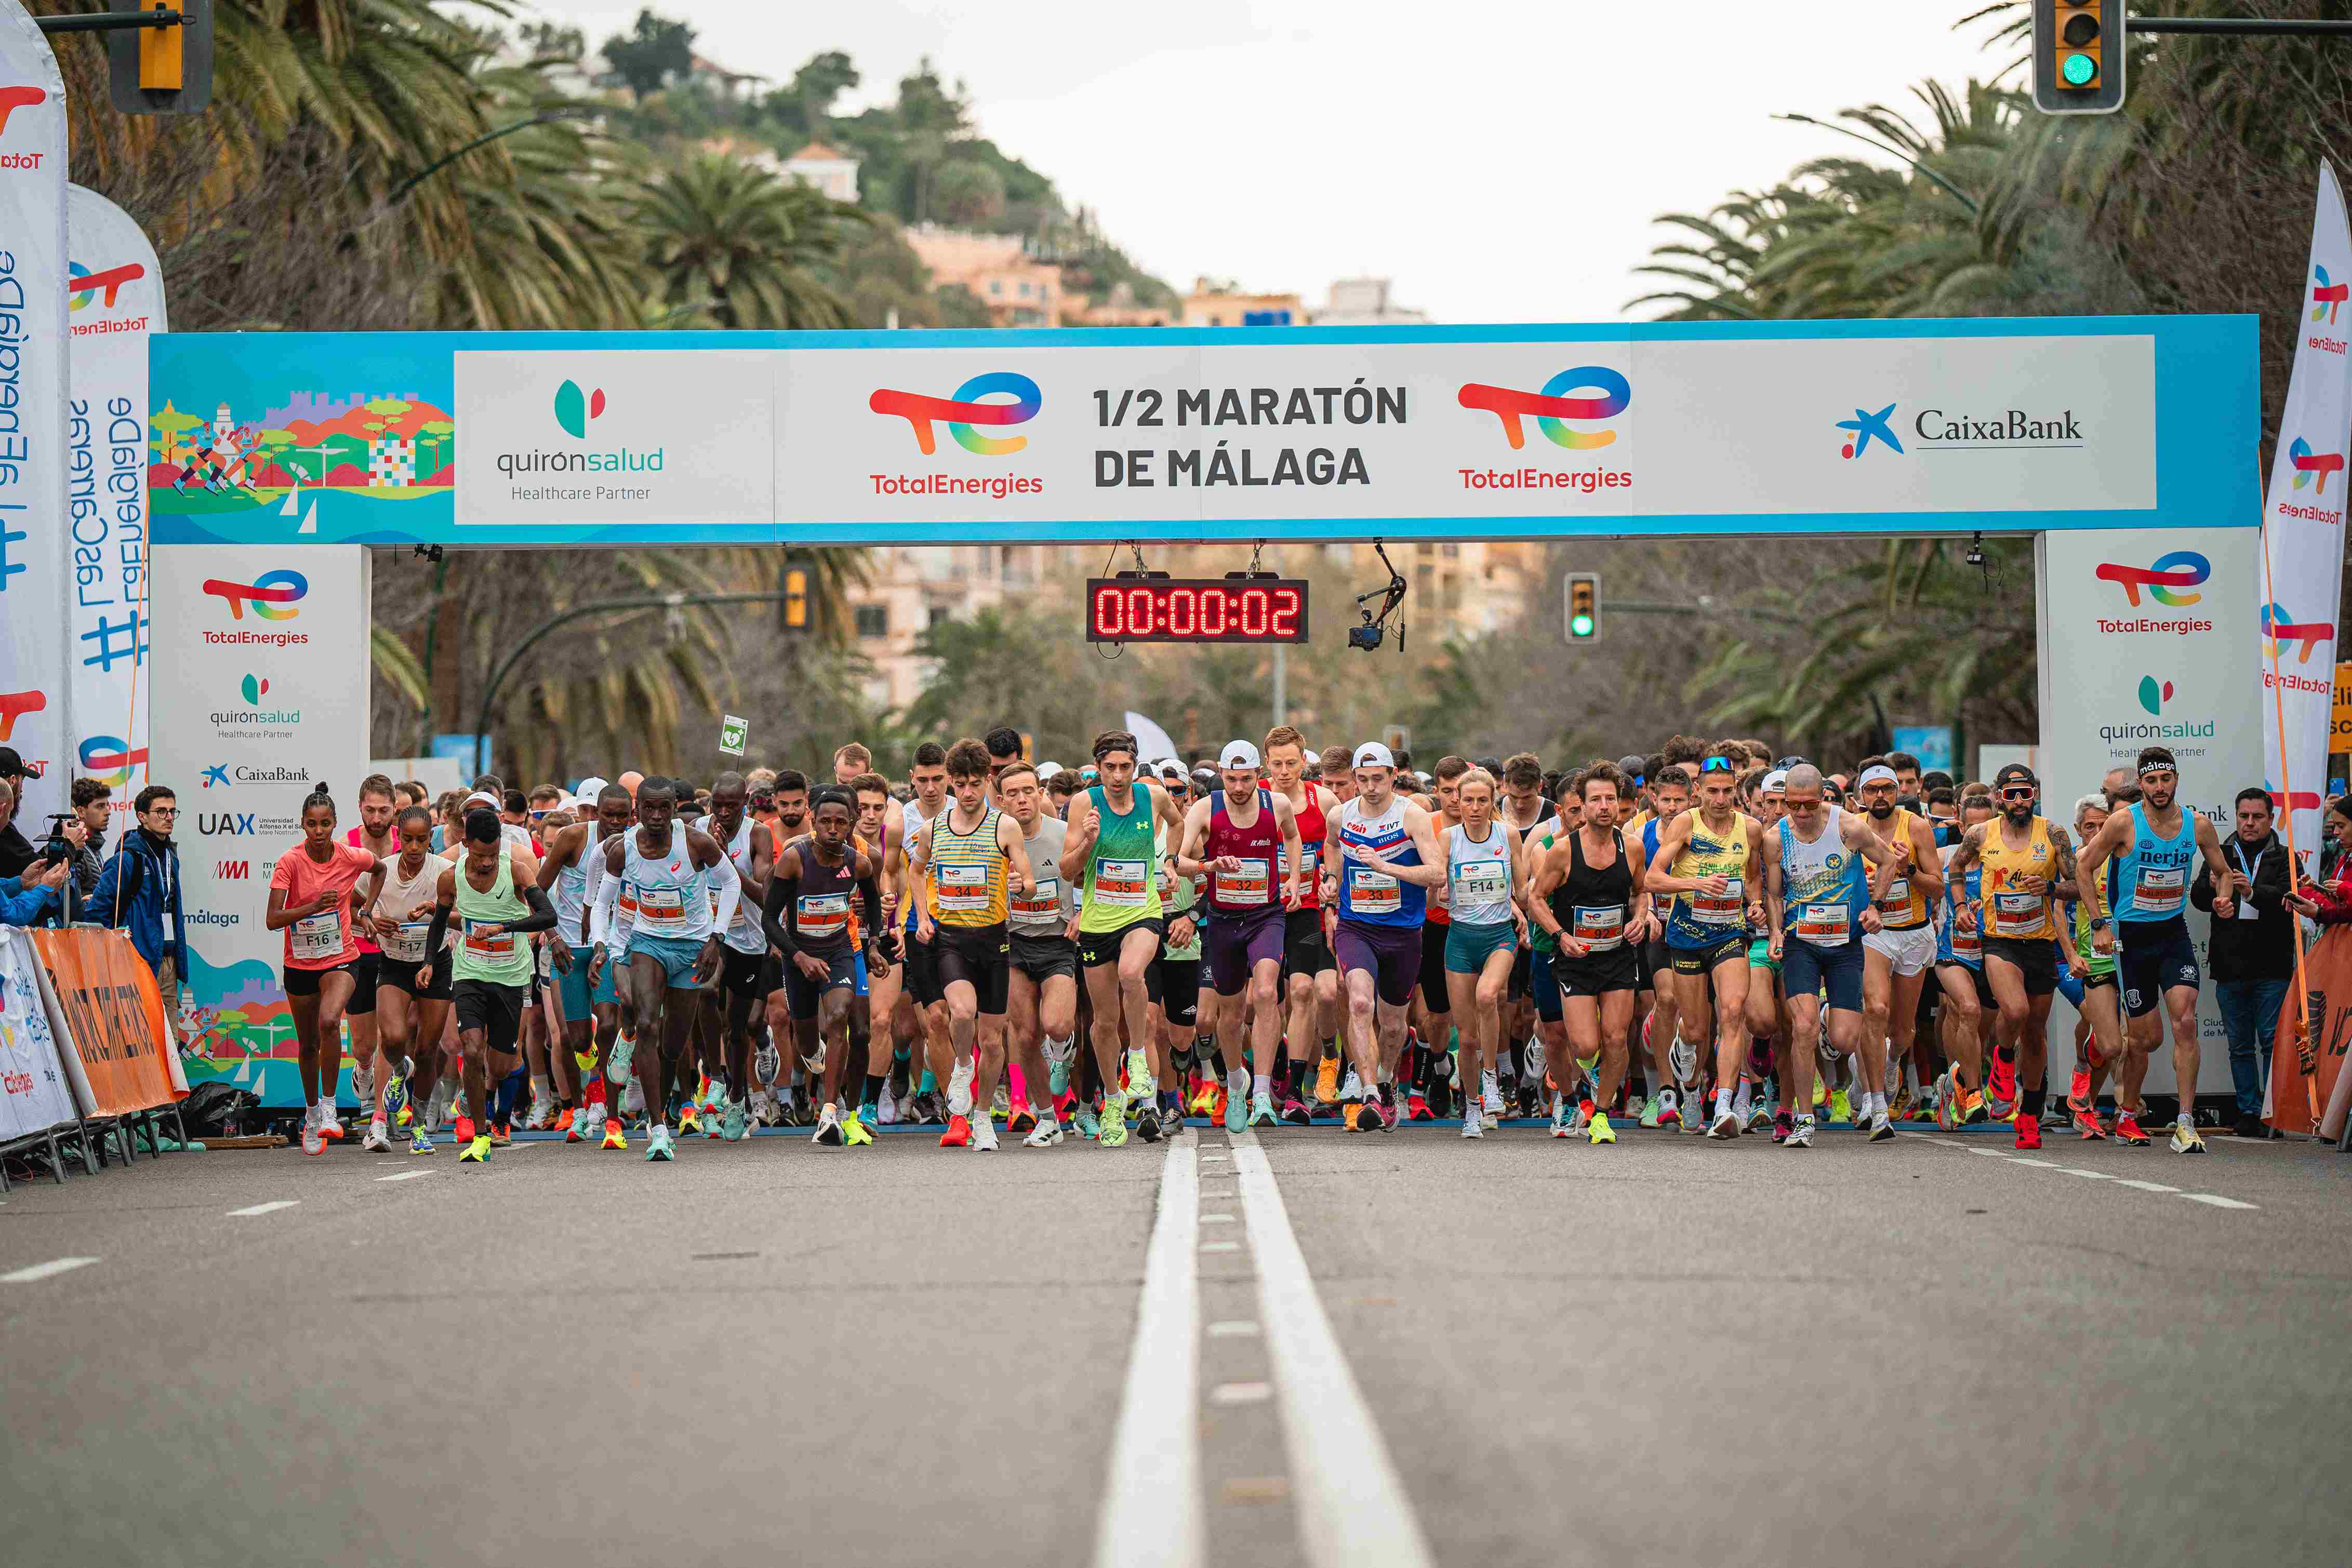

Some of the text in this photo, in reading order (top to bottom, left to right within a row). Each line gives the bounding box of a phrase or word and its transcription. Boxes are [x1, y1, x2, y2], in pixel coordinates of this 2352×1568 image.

[1094, 377, 1406, 427] 1/2 MARATÓN
[1916, 410, 2083, 441] CaixaBank
[497, 447, 663, 480] quirónsalud
[1095, 439, 1371, 487] DE MÁLAGA
[870, 472, 1043, 499] TotalEnergies
[1458, 467, 1632, 493] TotalEnergies
[512, 486, 650, 500] Healthcare Partner
[1096, 588, 1298, 635] 00:00:02
[2096, 617, 2212, 635] TotalEnergies
[203, 631, 308, 647] TotalEnergies
[210, 710, 300, 727] quirónsalud
[218, 730, 261, 738] Healthcare
[2099, 720, 2214, 744] quirónsalud
[235, 766, 310, 781] CaixaBank
[198, 813, 255, 836] UAX
[1387, 821, 1400, 830] IVT
[1378, 832, 1399, 844] BIOS
[2140, 848, 2190, 868] nerja
[955, 885, 972, 897] 34
[1114, 881, 1131, 893] 35
[1236, 880, 1252, 891] 32
[1469, 881, 1494, 893] F14
[1368, 889, 1384, 900] 33
[1026, 901, 1048, 912] 102
[1712, 900, 1728, 911] 96
[183, 909, 240, 927] málaga
[656, 908, 664, 918] 9
[1594, 928, 1610, 940] 92
[1818, 923, 1833, 935] 39
[306, 934, 329, 946] F16
[398, 941, 422, 952] F17
[487, 942, 494, 952] 5
